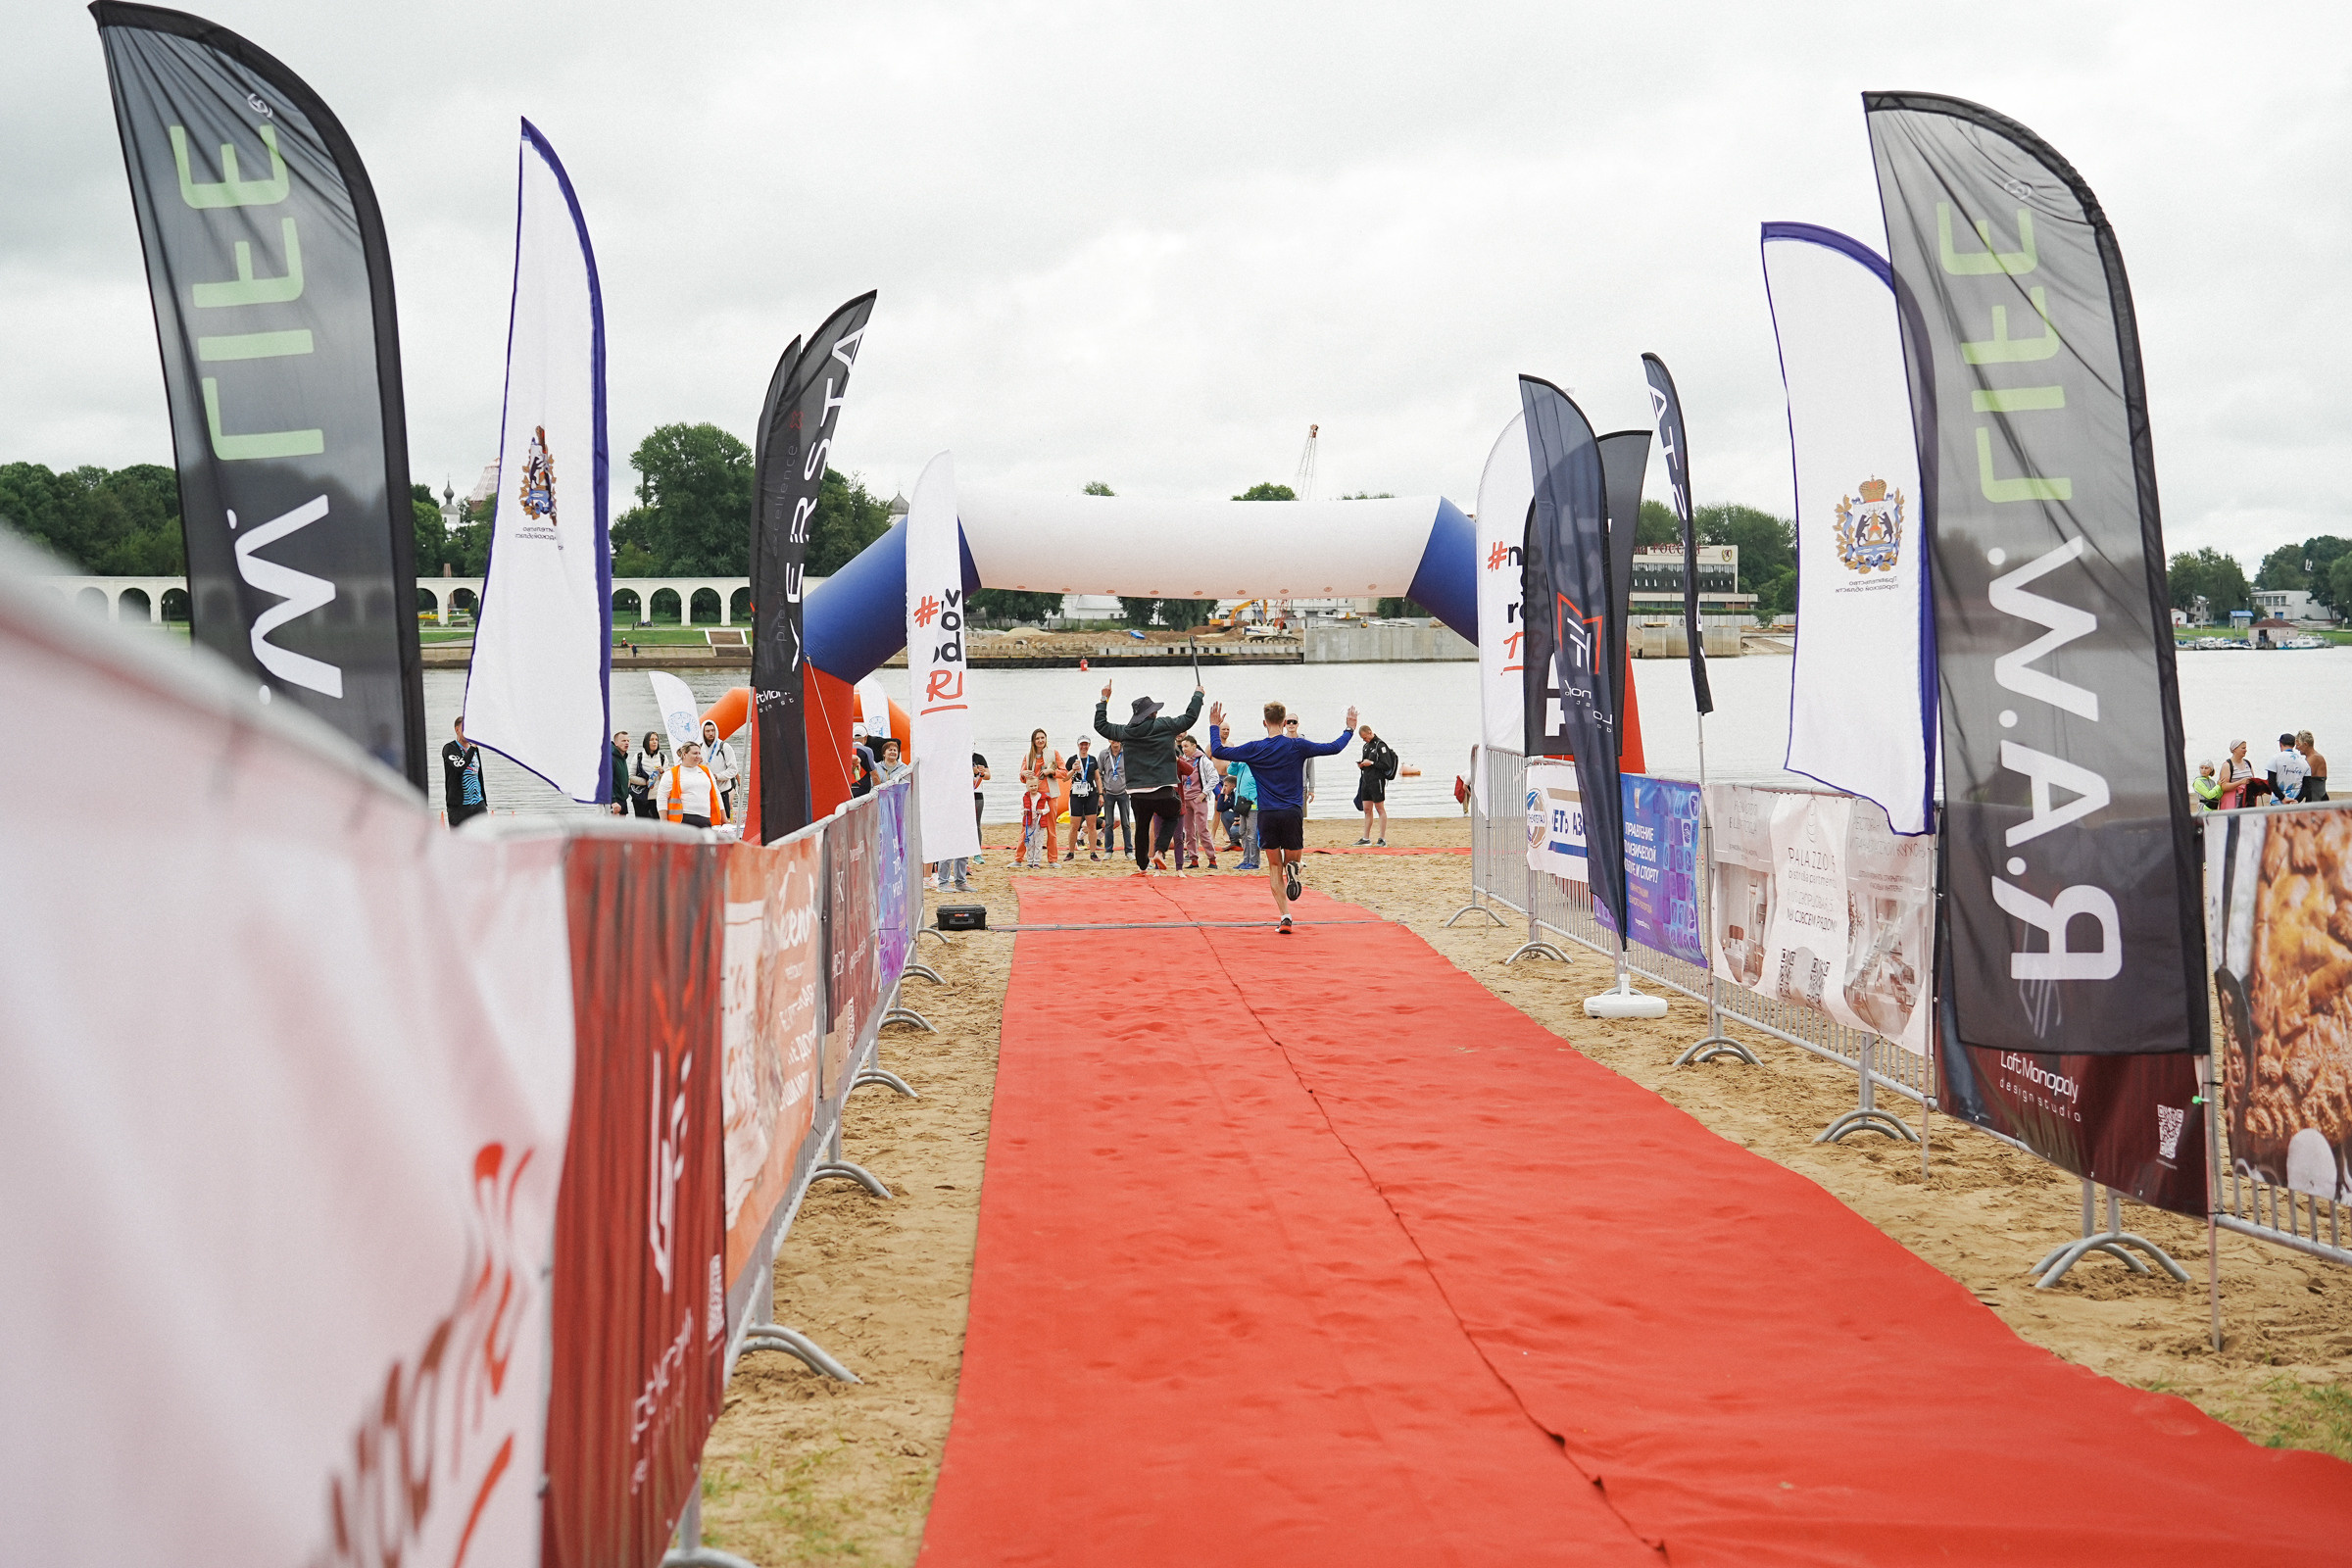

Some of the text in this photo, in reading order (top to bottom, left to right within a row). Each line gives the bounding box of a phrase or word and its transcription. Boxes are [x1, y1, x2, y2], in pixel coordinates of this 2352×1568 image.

[785, 323, 866, 672] VERSTA
[1624, 821, 1654, 842] ПРАВЛЕНИЕ
[1787, 847, 1829, 871] PALAZZO
